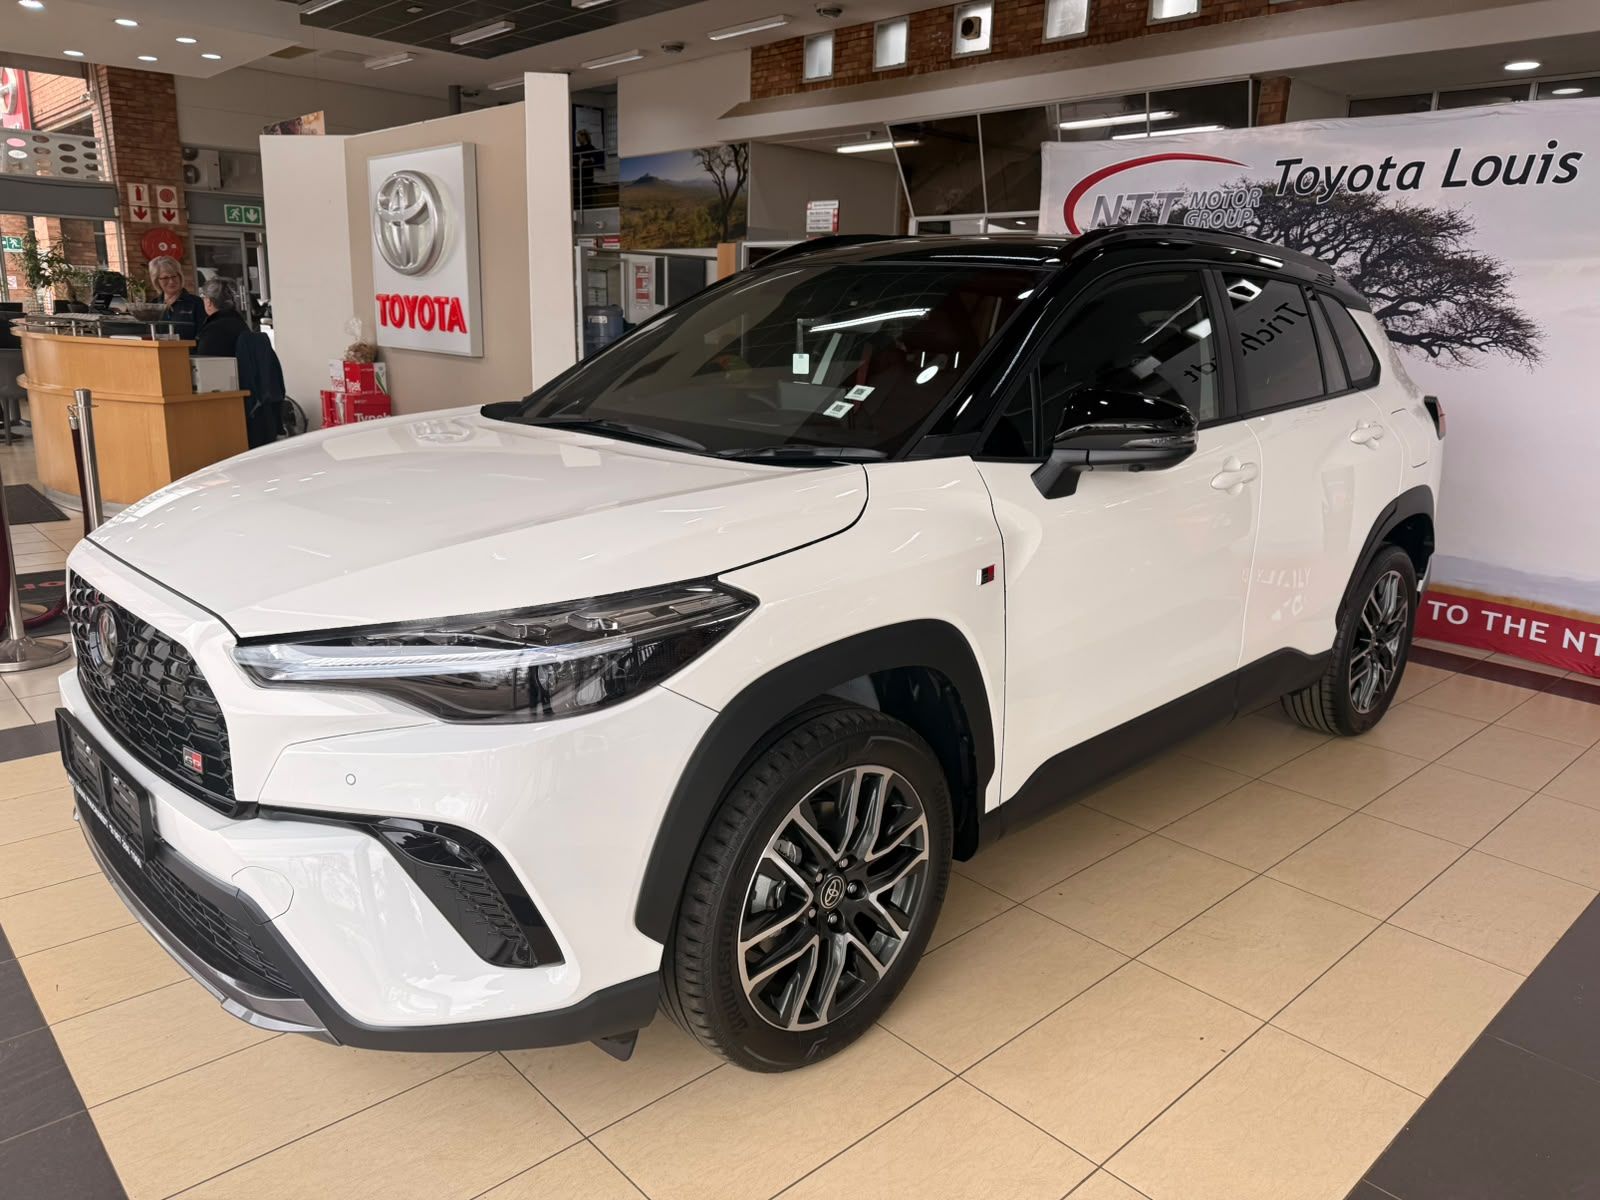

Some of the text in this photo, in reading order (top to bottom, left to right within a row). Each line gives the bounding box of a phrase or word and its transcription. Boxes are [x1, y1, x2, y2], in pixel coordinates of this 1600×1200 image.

[1275, 139, 1584, 203] Toyota Louis
[1089, 191, 1185, 230] NTT
[1184, 208, 1254, 230] GROUP
[1189, 188, 1263, 210] MOTOR
[376, 293, 468, 335] TOYOTA
[1427, 600, 1469, 625] TO
[1481, 610, 1550, 644] THE
